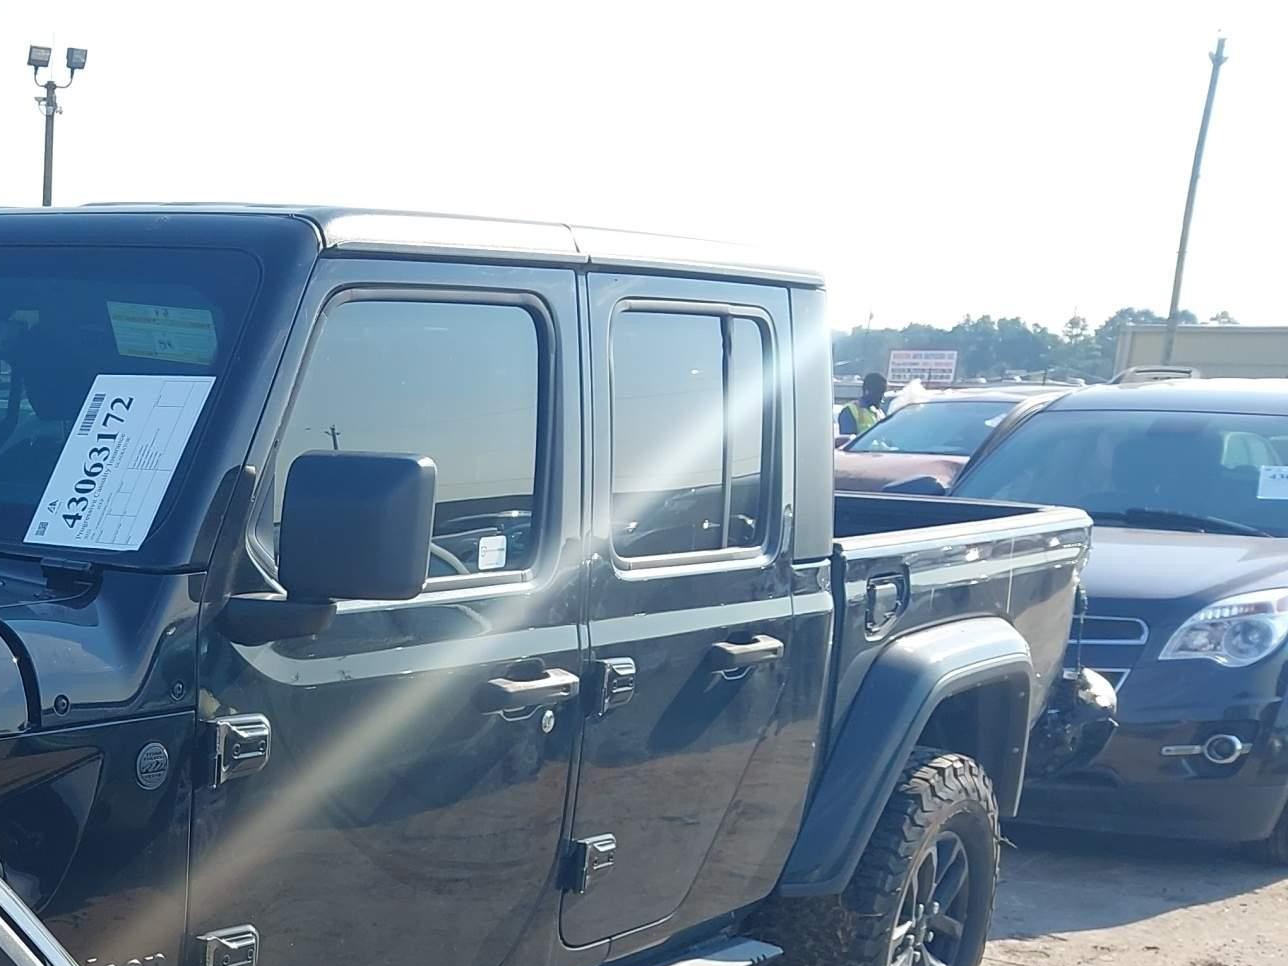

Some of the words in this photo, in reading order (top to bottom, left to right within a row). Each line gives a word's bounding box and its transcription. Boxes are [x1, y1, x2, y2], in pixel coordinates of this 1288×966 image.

[62, 396, 134, 529] 43063172
[92, 468, 112, 498] Casualty
[106, 433, 126, 466] Insurance
